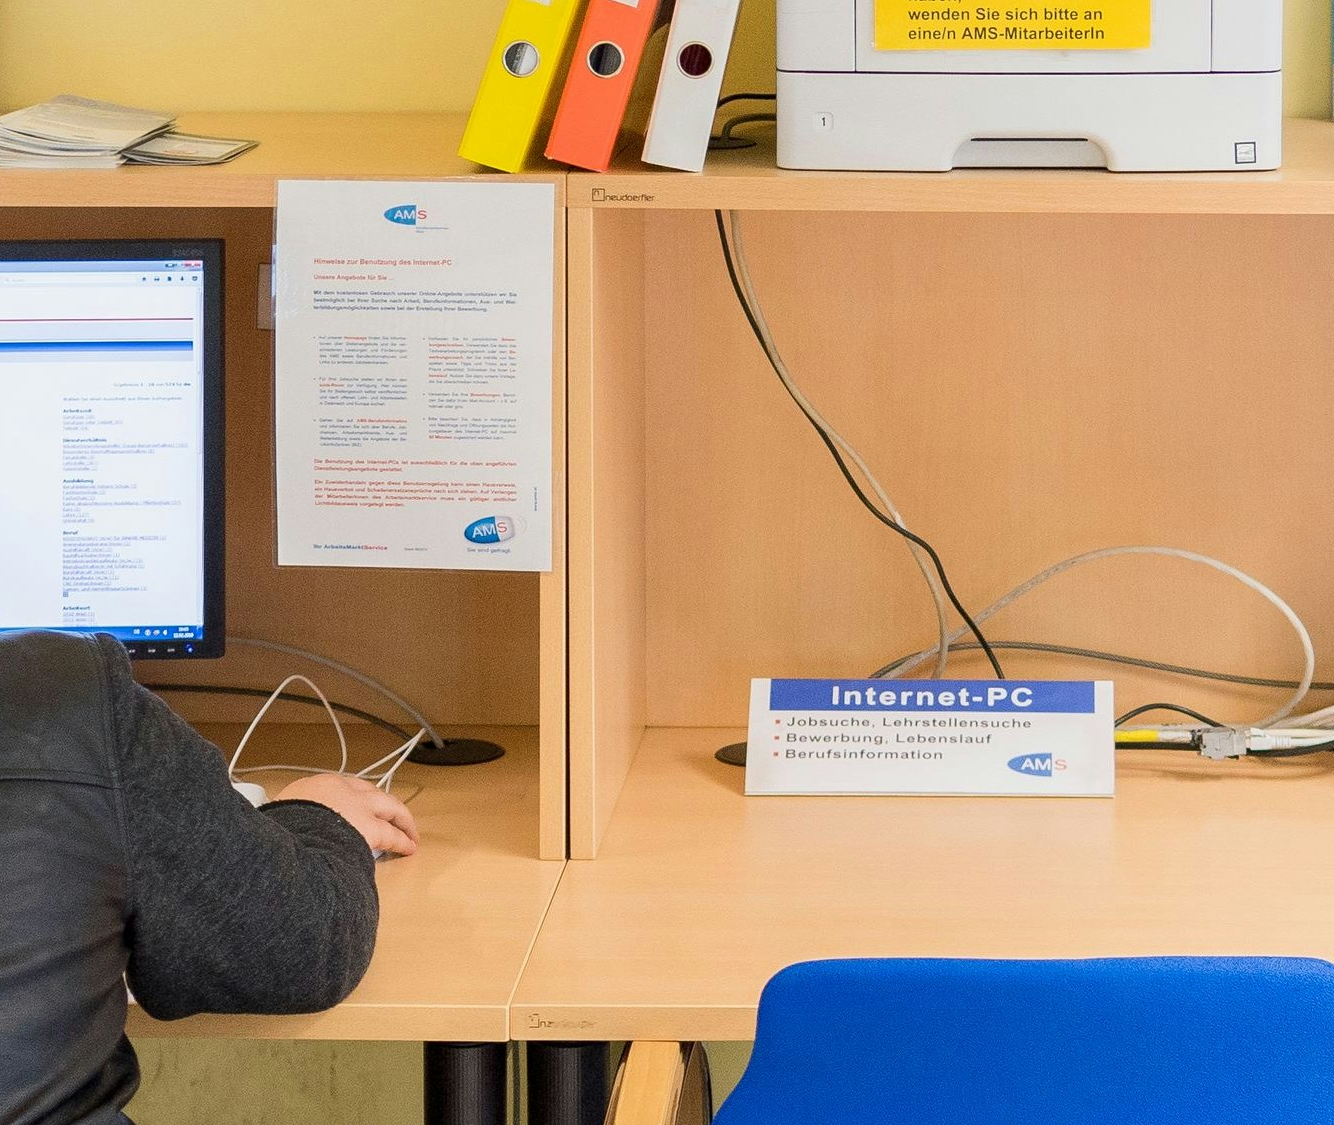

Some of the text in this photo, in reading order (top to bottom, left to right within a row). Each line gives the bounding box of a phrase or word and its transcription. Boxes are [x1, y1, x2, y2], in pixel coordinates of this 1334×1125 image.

[908, 7, 1103, 21] wenden Sie sich bitte an
[908, 26, 1105, 40] eine/n AMS-MitarbeiterIn
[393, 209, 427, 220] AMS
[360, 259, 397, 267] Benutzung
[471, 521, 508, 539] AMS
[831, 685, 1034, 708] Internet-PC
[786, 716, 1032, 729] Jobsuche, Lehrstellensuche
[786, 732, 993, 746] Bewerbung, Lebenslauf
[785, 748, 944, 761] Berufsinformation
[1020, 758, 1068, 771] AMS
